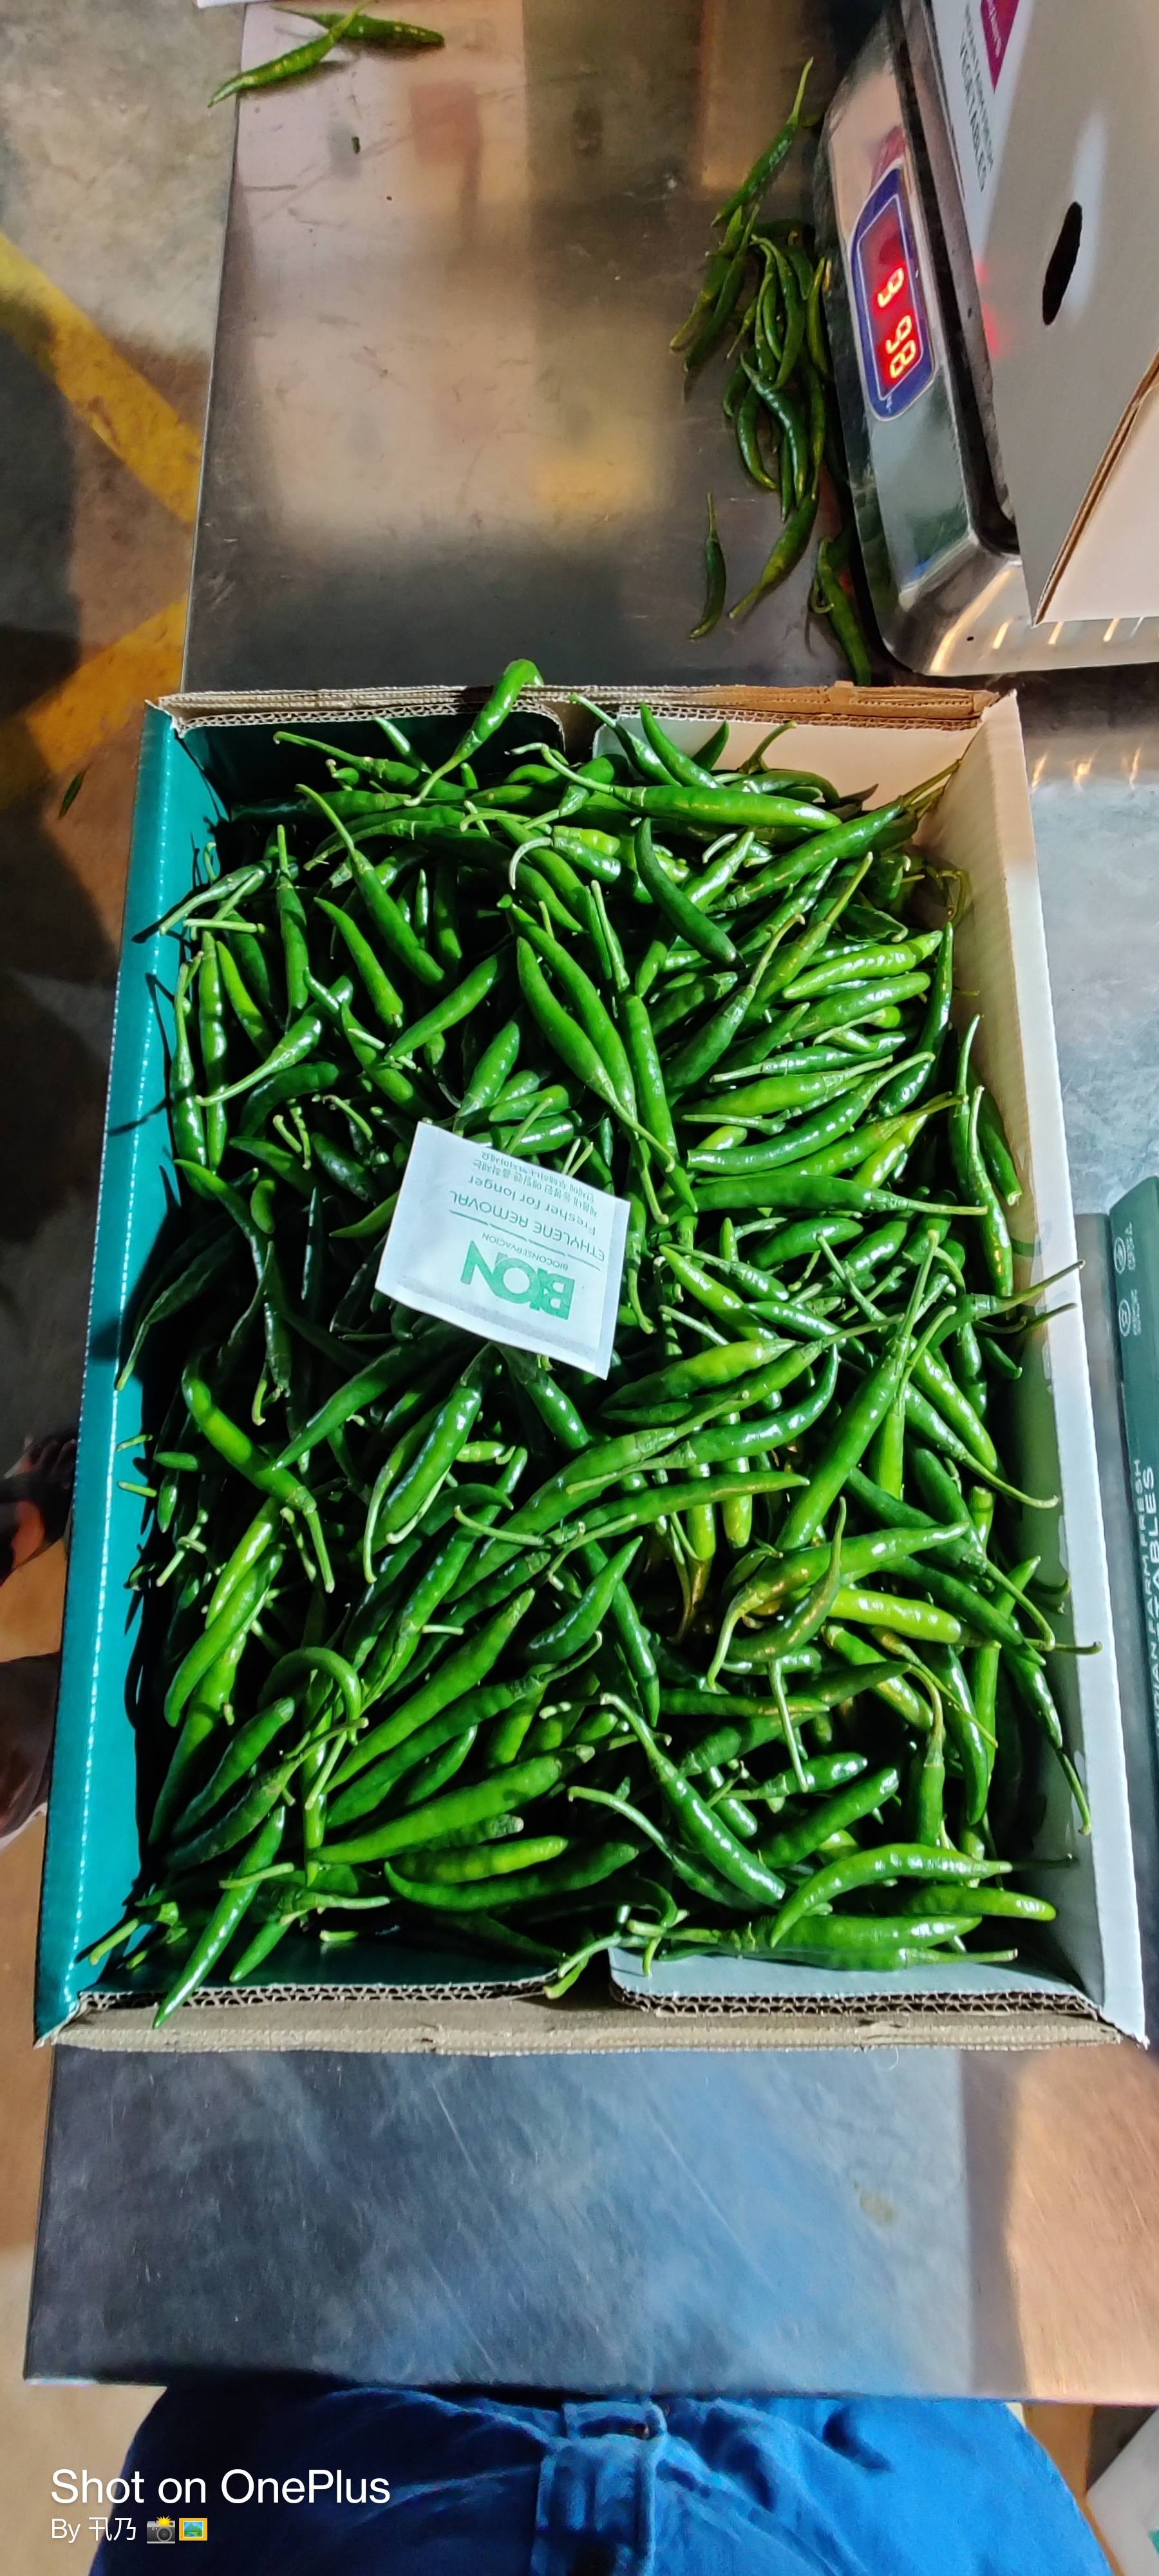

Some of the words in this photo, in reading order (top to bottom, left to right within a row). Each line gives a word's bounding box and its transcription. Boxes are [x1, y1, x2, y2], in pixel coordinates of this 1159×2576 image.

[467, 1175, 516, 1201] longer
[520, 1197, 541, 1210] for
[450, 1191, 529, 1228] REMOVAL
[545, 1203, 596, 1236] Fresher
[482, 1232, 569, 1271] BIOCONSERVACION
[532, 1222, 605, 1262] ETHYLENE
[460, 1240, 575, 1320] BION
[1133, 1459, 1148, 1547] FRESH
[1142, 1553, 1156, 1634] FARM
